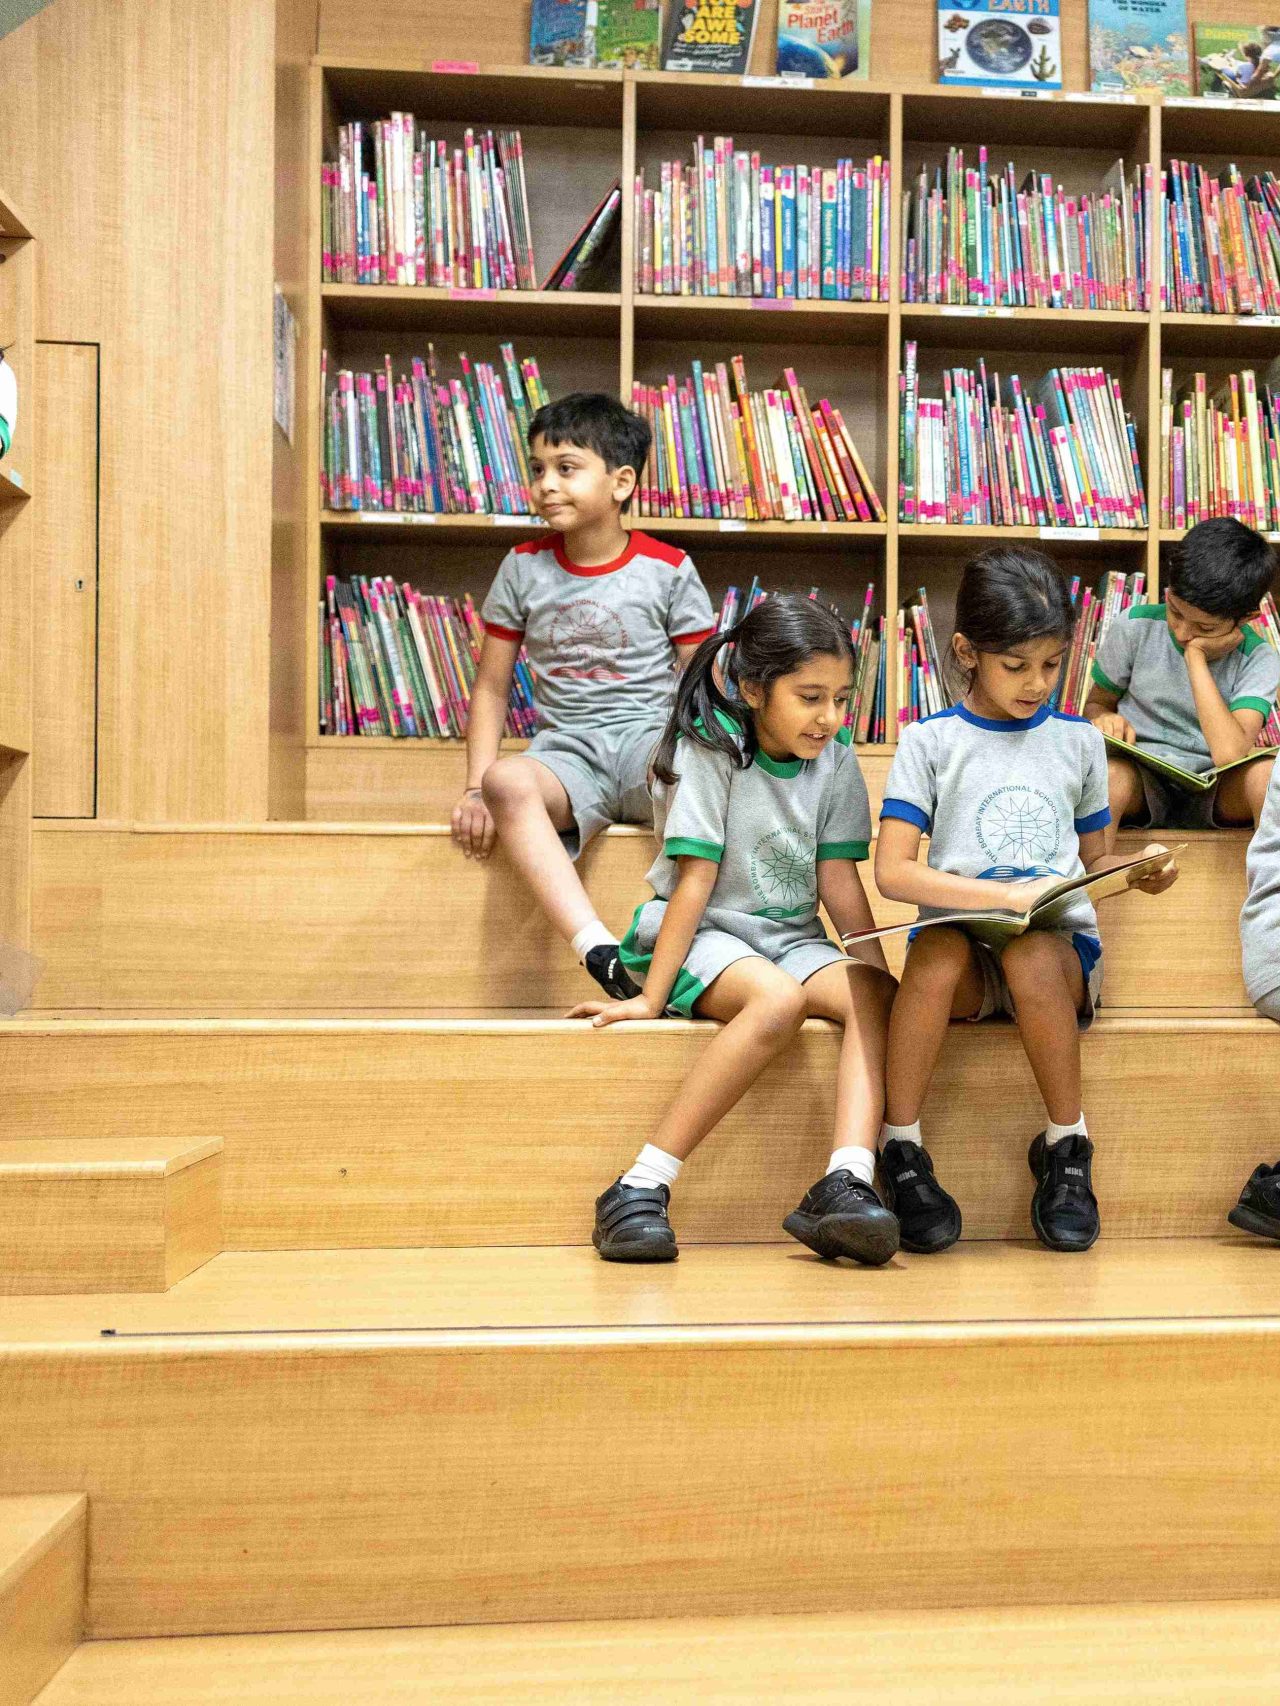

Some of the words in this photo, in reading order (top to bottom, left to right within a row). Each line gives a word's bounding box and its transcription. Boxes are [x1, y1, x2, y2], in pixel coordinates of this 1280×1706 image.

[696, 5, 736, 18] ARE
[787, 10, 838, 29] Planet
[691, 17, 737, 32] AWE
[816, 20, 854, 43] Earth
[684, 30, 741, 45] SOME
[978, 785, 1032, 816] INTERNATIONAL
[1034, 789, 1059, 816] SCHOOL
[753, 827, 801, 853] INTERNATIONAL
[985, 848, 998, 863] THE
[750, 854, 760, 892] BOMBAY
[757, 890, 769, 905] THE
